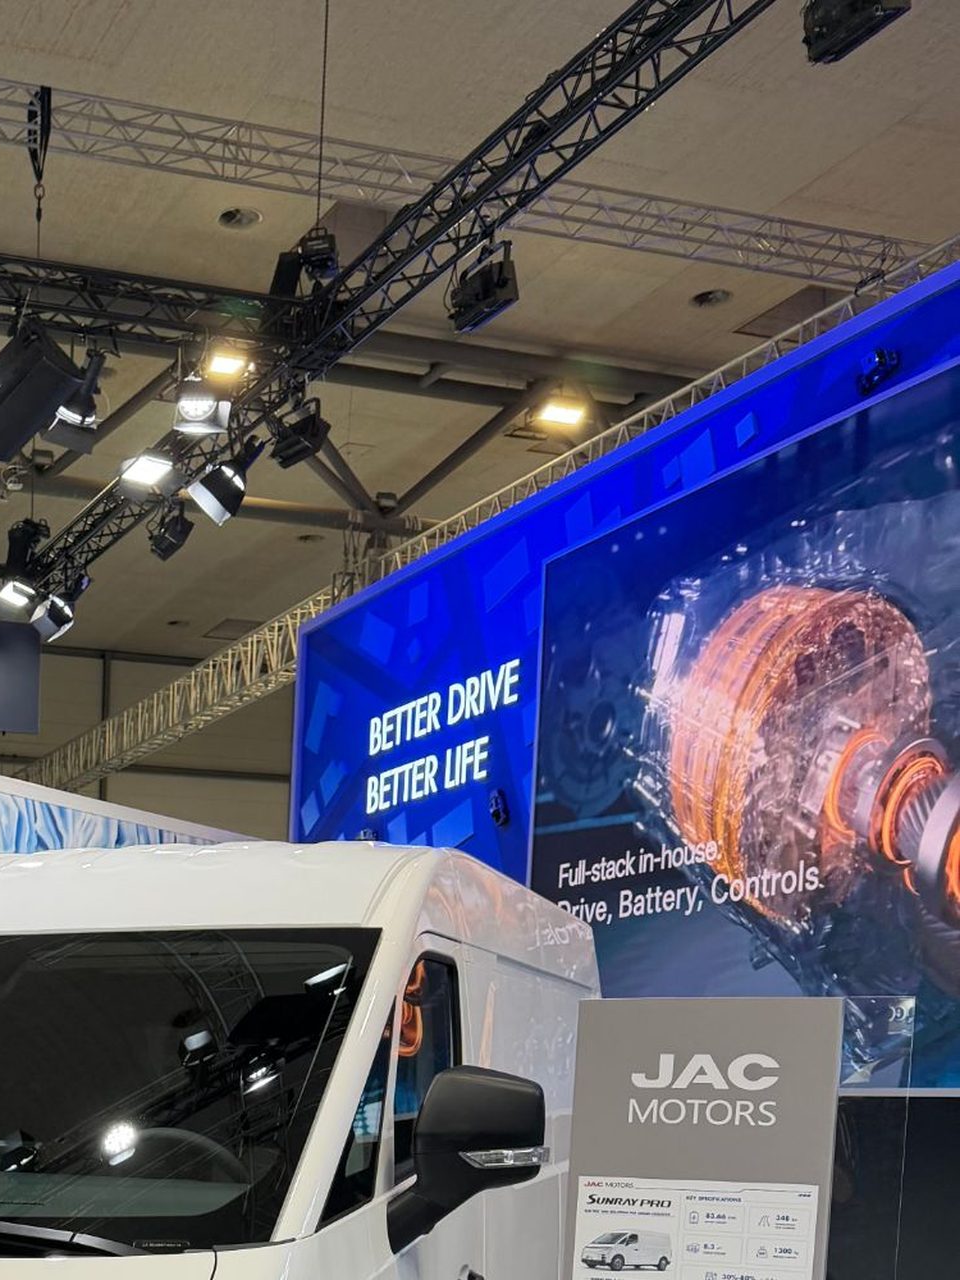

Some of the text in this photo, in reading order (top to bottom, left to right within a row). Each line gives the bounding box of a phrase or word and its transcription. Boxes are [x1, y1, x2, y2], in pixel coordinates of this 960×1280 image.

[369, 658, 520, 756] BETTER DRIVE
[366, 735, 489, 814] BETTER LIFE
[558, 850, 635, 888] Full-stack
[618, 884, 702, 918] Battery,
[631, 1053, 780, 1091] JAC
[628, 1098, 777, 1127] MOTORS
[587, 1194, 672, 1208] SUNRAY PRO
